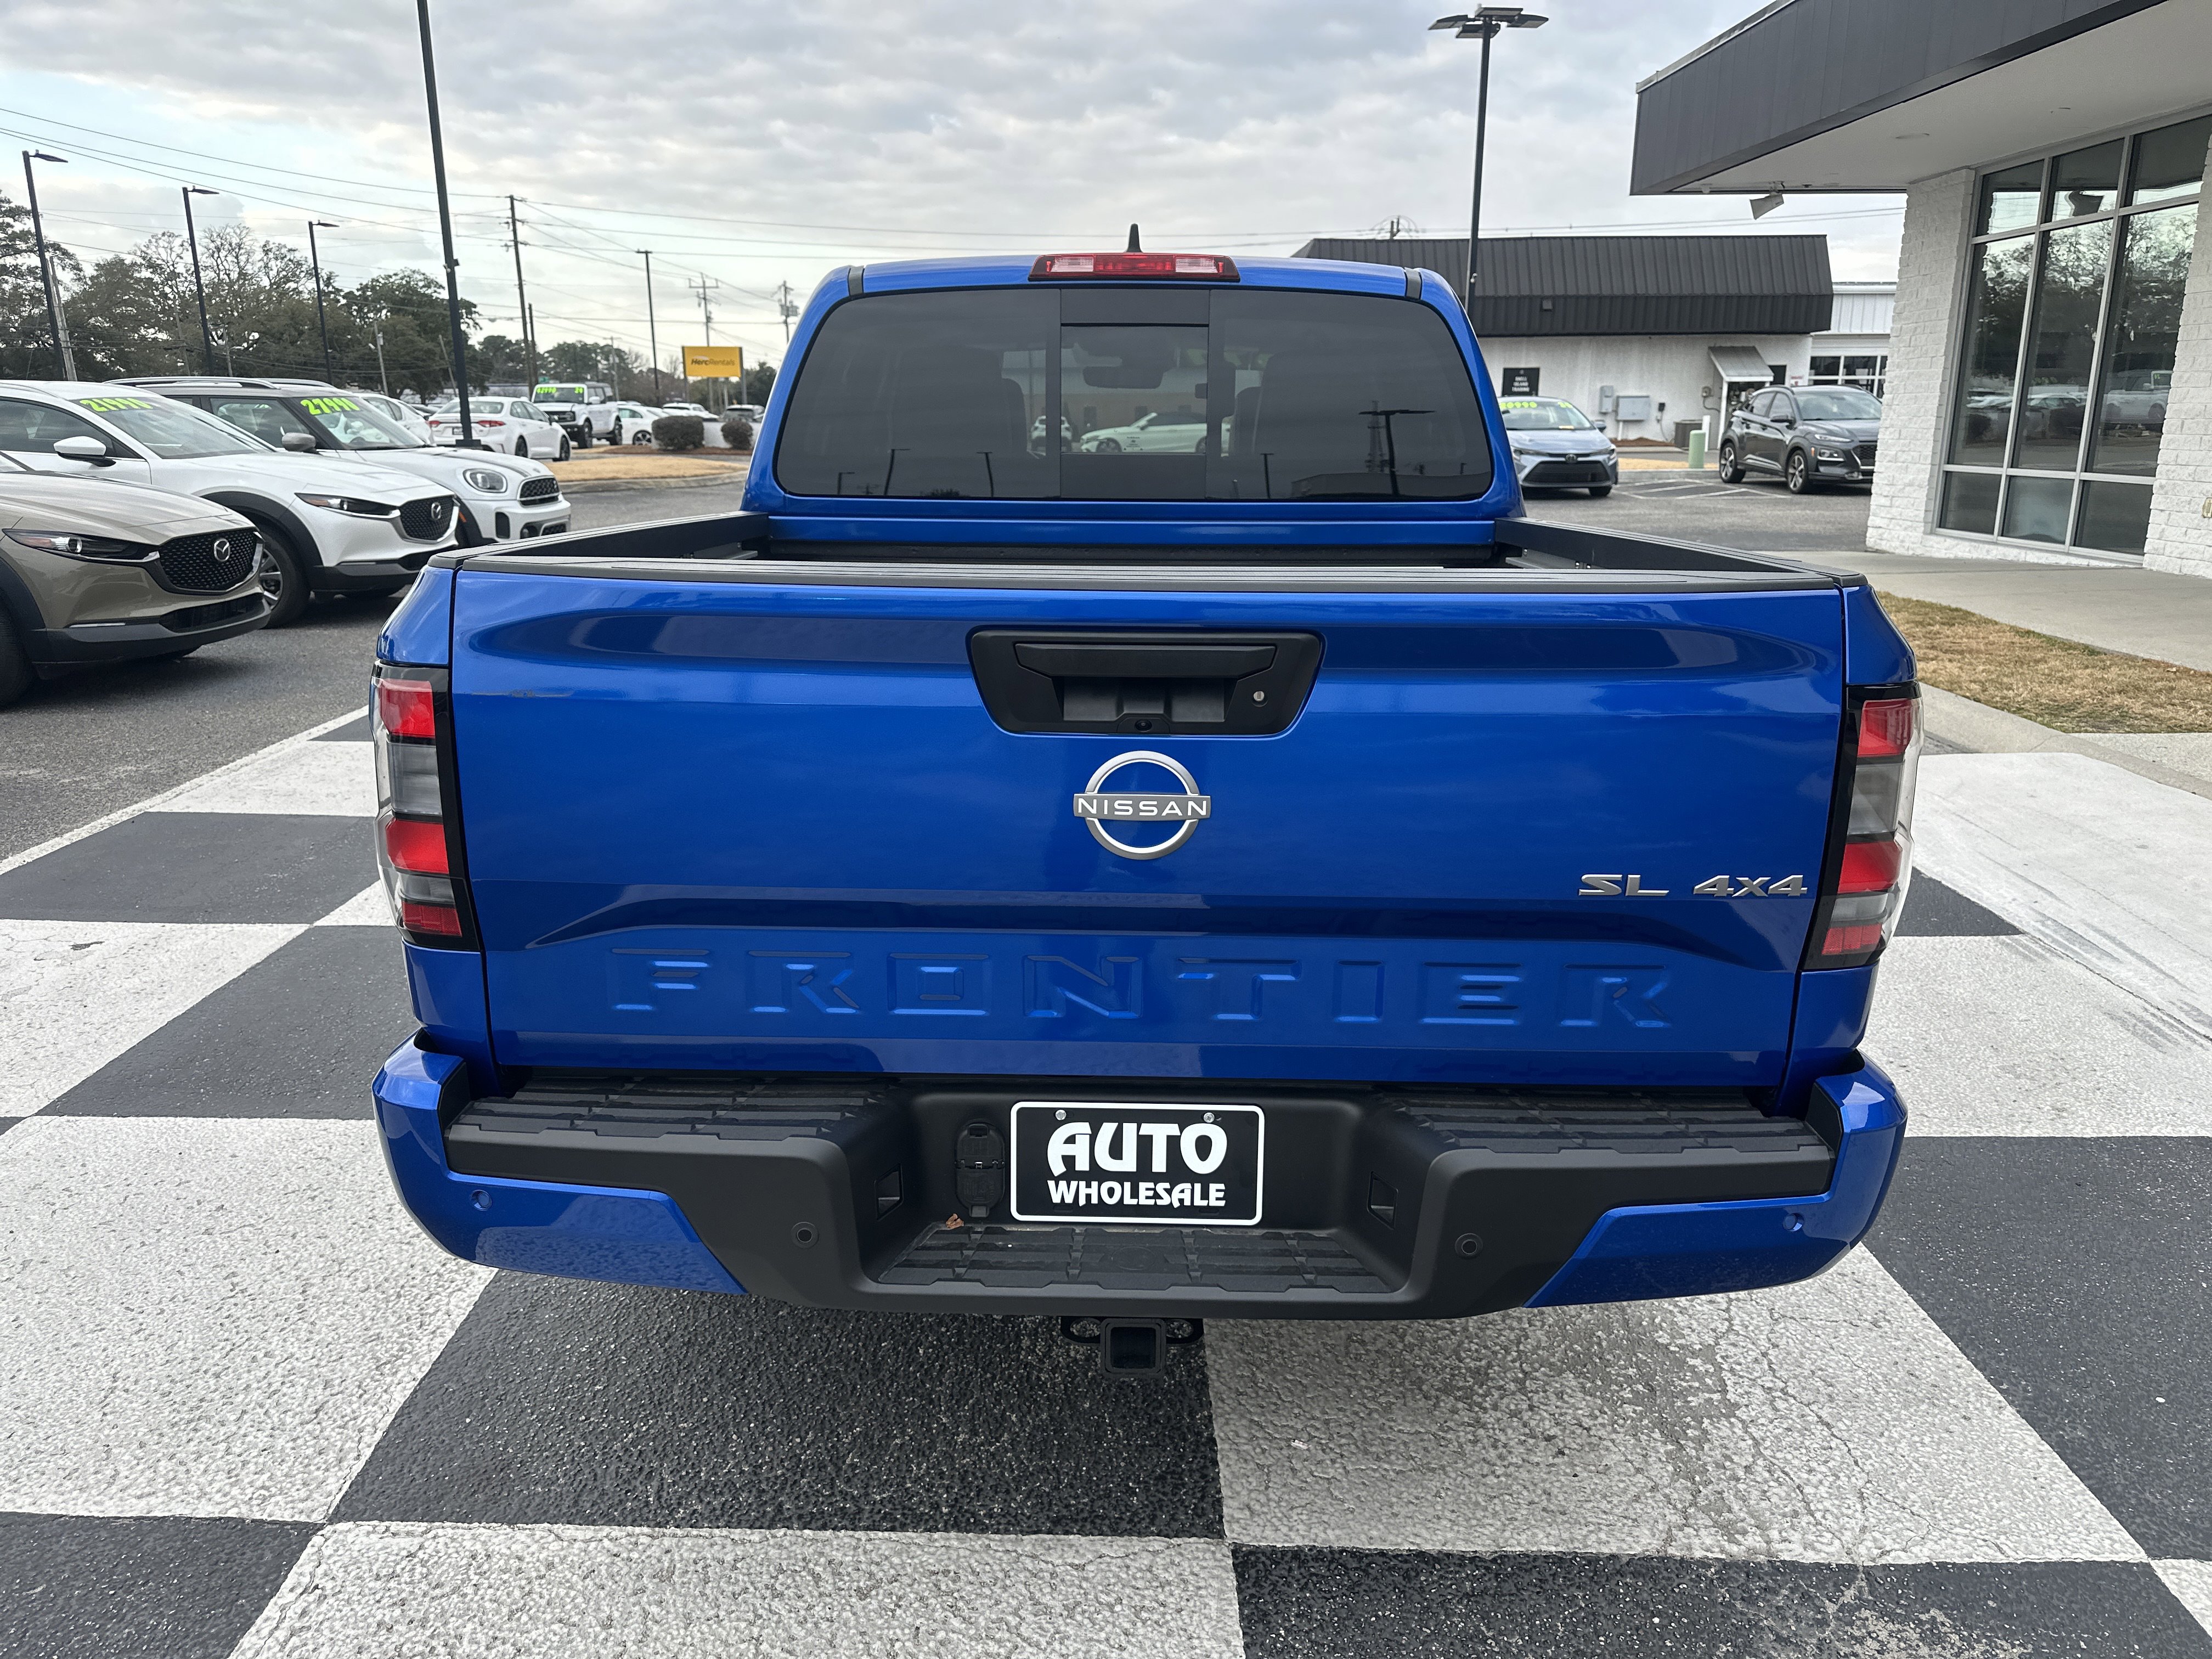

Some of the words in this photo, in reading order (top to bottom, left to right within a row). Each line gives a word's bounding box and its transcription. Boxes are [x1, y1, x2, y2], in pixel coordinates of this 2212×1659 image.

[300, 397, 360, 415] 27990
[1077, 798, 1207, 816] NISSAN
[1578, 874, 1670, 896] SL
[610, 947, 1674, 1028] FRONTIER
[1047, 1121, 1228, 1176] AUTO
[1047, 1180, 1227, 1209] WHOLESALE
